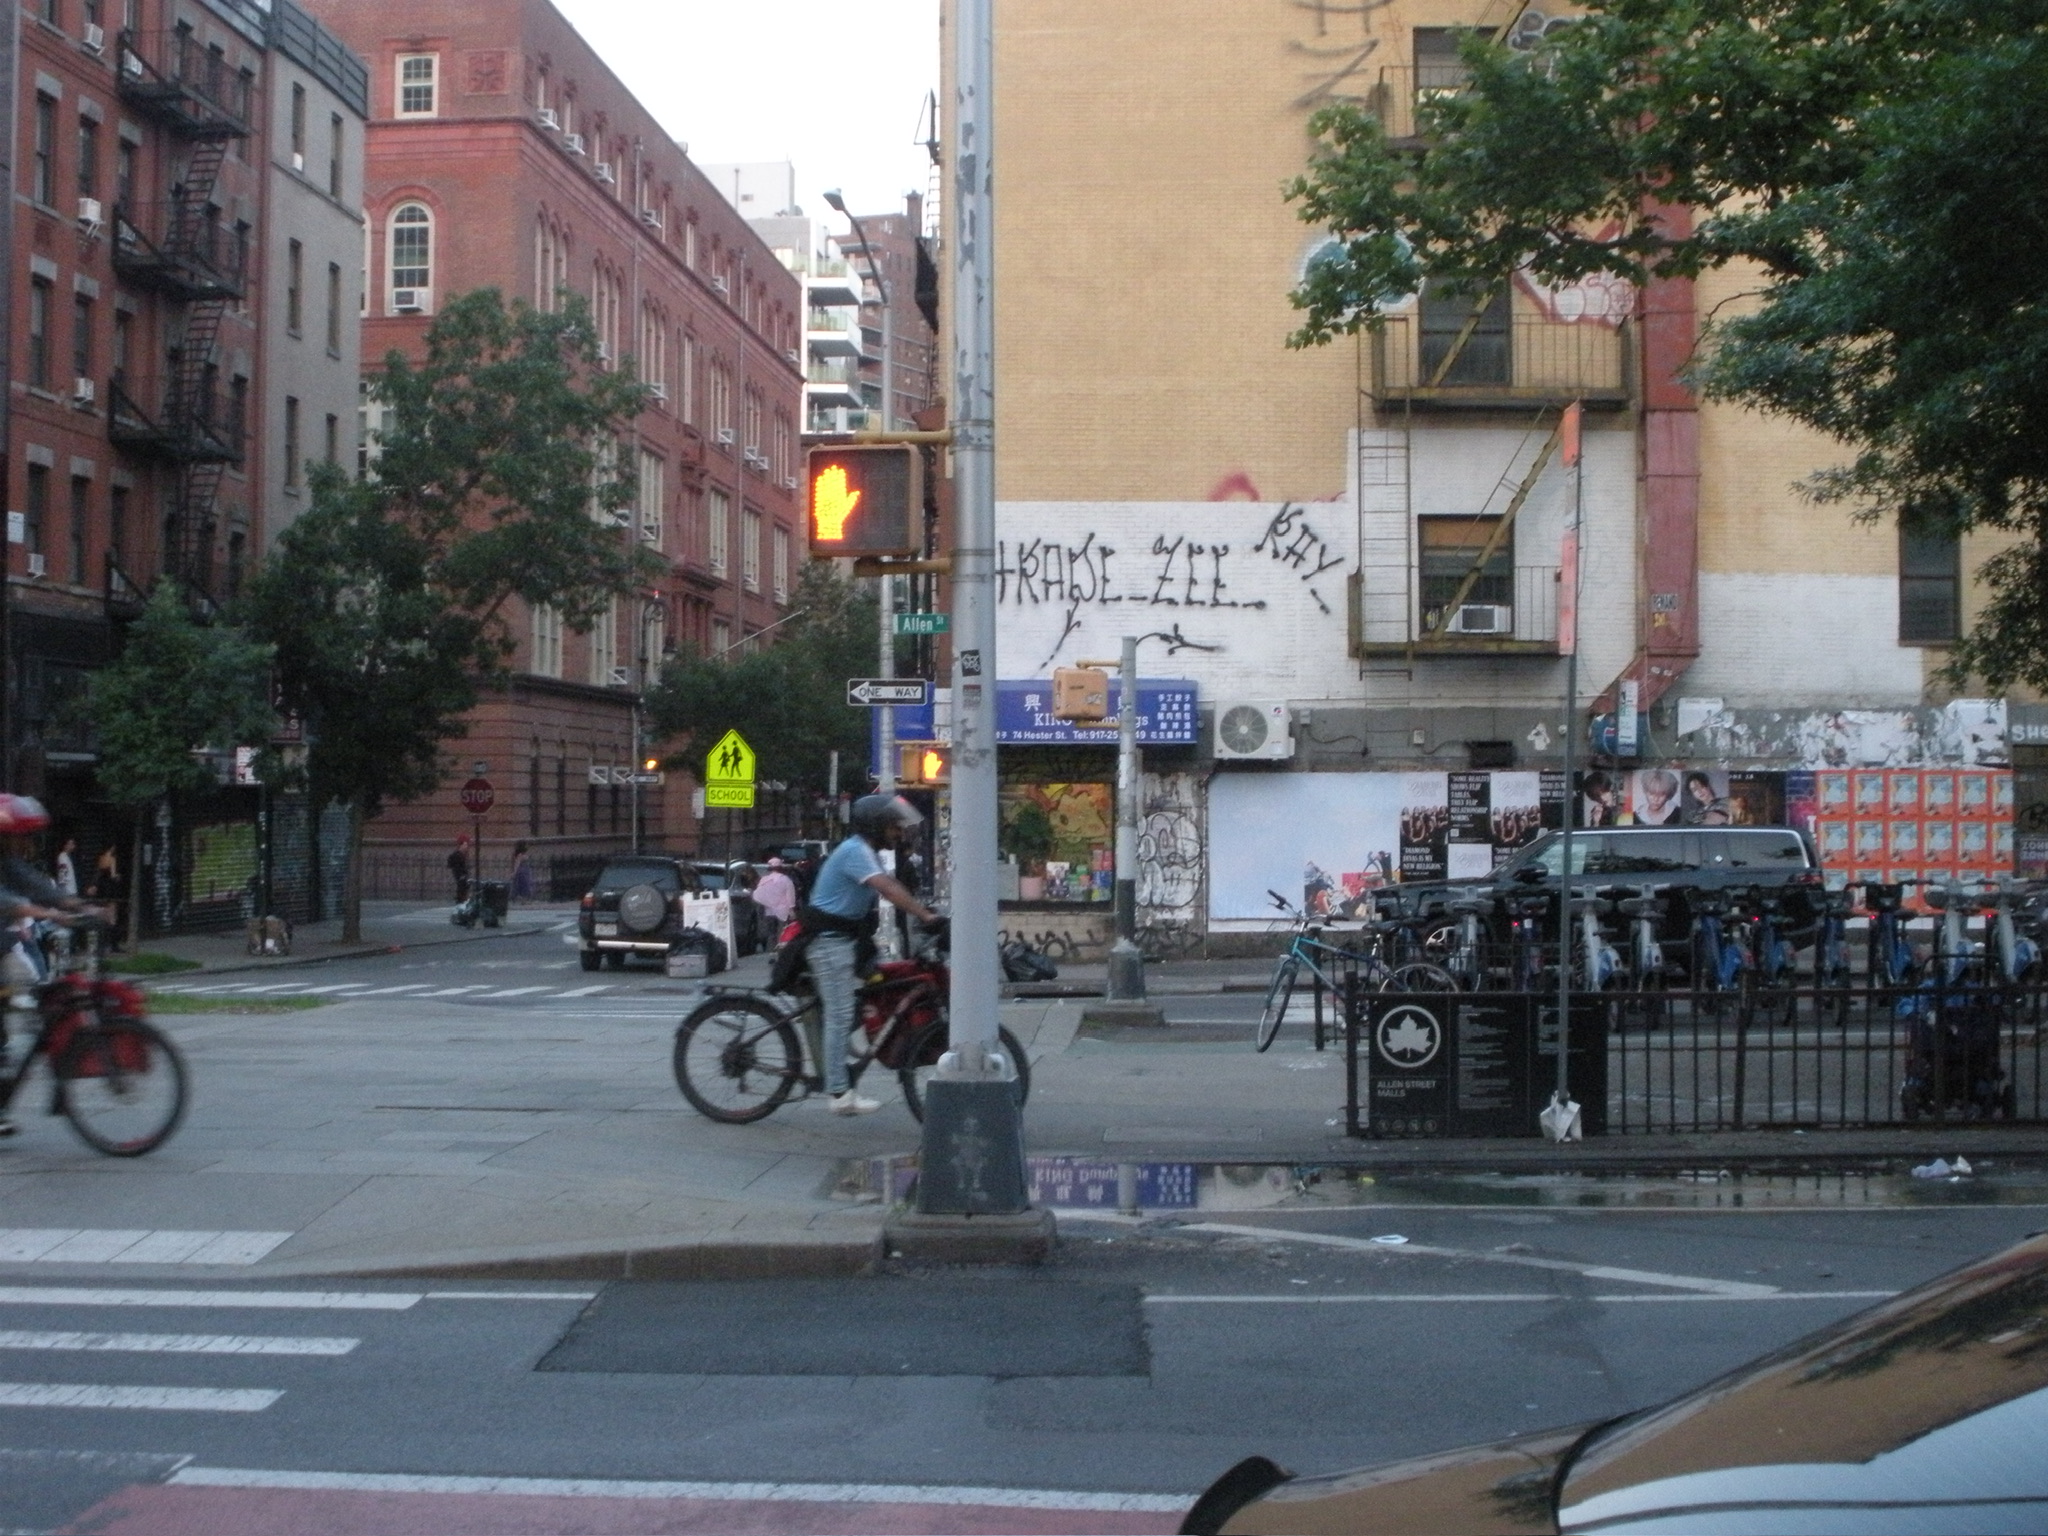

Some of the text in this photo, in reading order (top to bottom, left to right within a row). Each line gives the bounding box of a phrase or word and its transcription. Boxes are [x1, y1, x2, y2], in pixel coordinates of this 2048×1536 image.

[903, 617, 933, 632] Allen
[860, 687, 919, 698] ONE WAY
[1024, 731, 1053, 739] Hester
[1055, 731, 1067, 739] St.
[461, 790, 493, 803] STOP
[710, 789, 750, 800] SCHOOL
[1377, 1080, 1436, 1088] ALLEN STREET
[1377, 1089, 1406, 1097] MALLS
